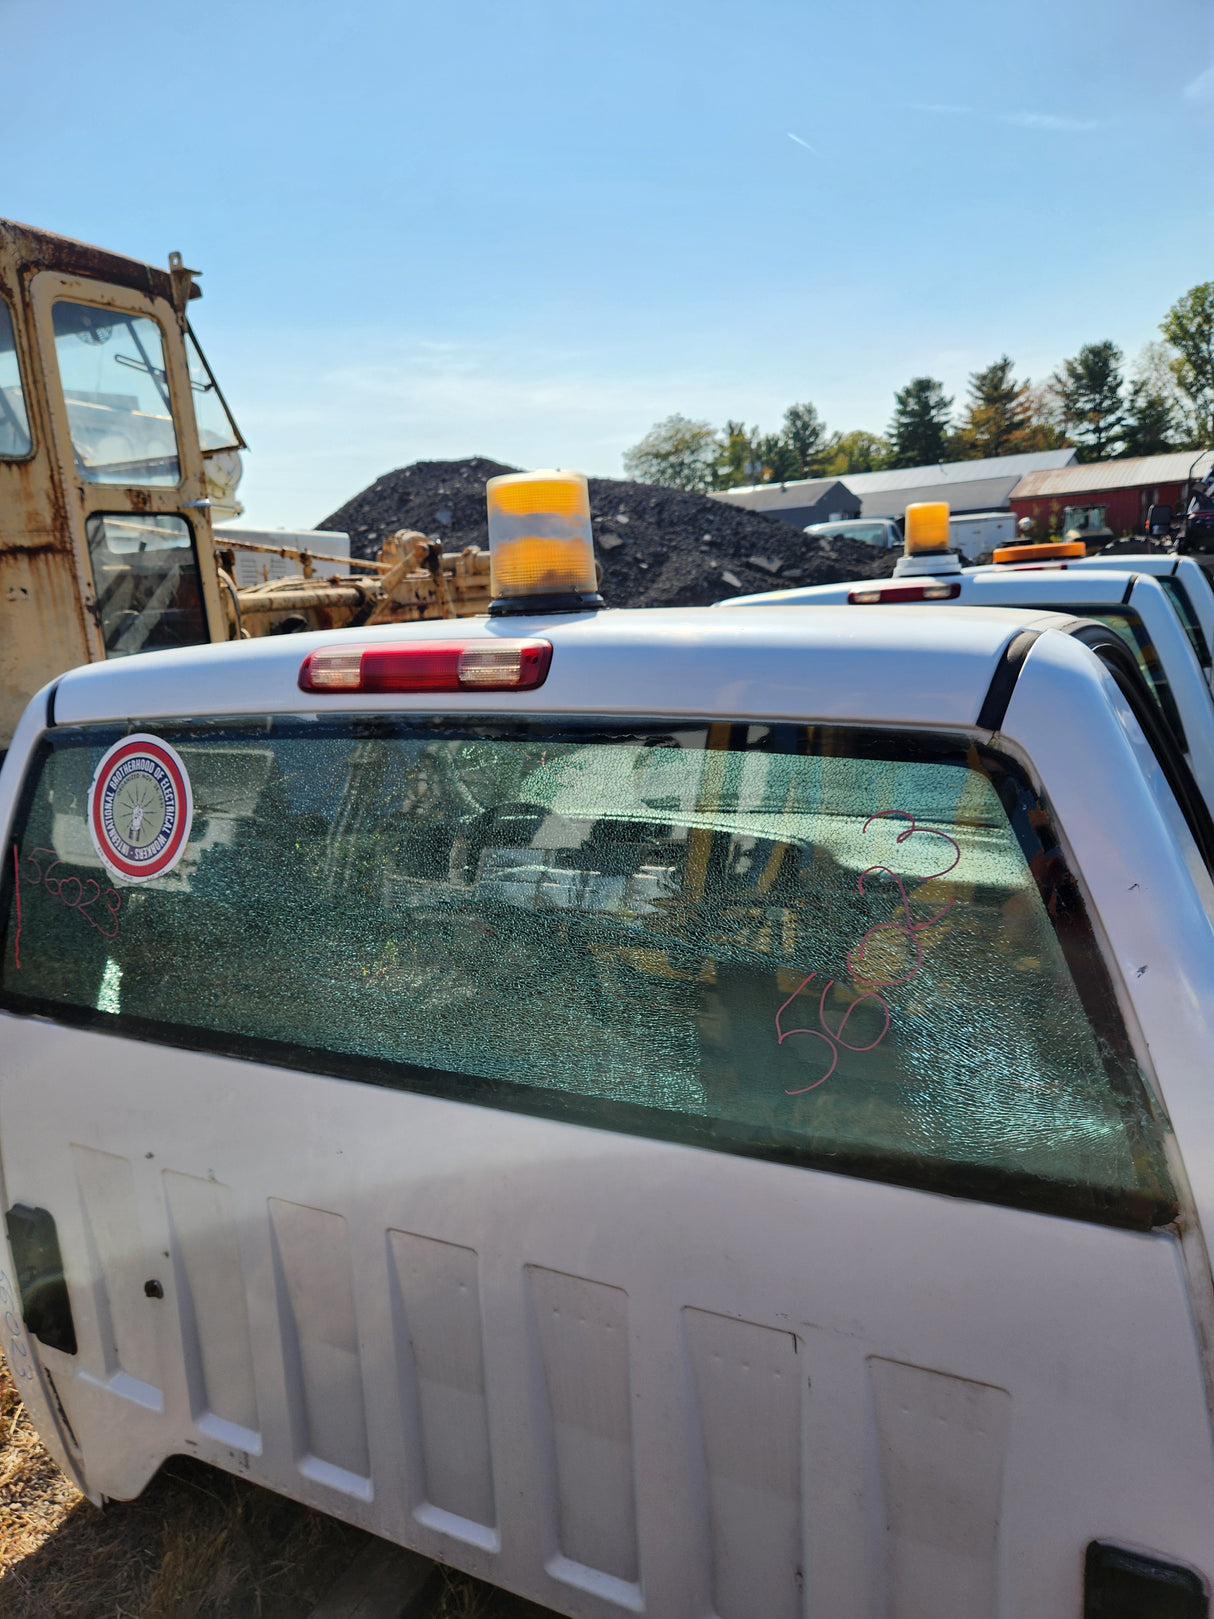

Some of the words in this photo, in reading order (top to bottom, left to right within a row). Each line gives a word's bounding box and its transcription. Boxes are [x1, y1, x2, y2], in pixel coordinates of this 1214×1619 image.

[109, 759, 156, 790] BROTHERHOOD
[153, 767, 165, 780] OF
[104, 791, 130, 856] INTERNATIONAL
[160, 778, 175, 834] ELECTRICAL
[134, 834, 167, 859] WORKERS
[21, 847, 121, 938] 56023
[775, 809, 960, 1095] 56023
